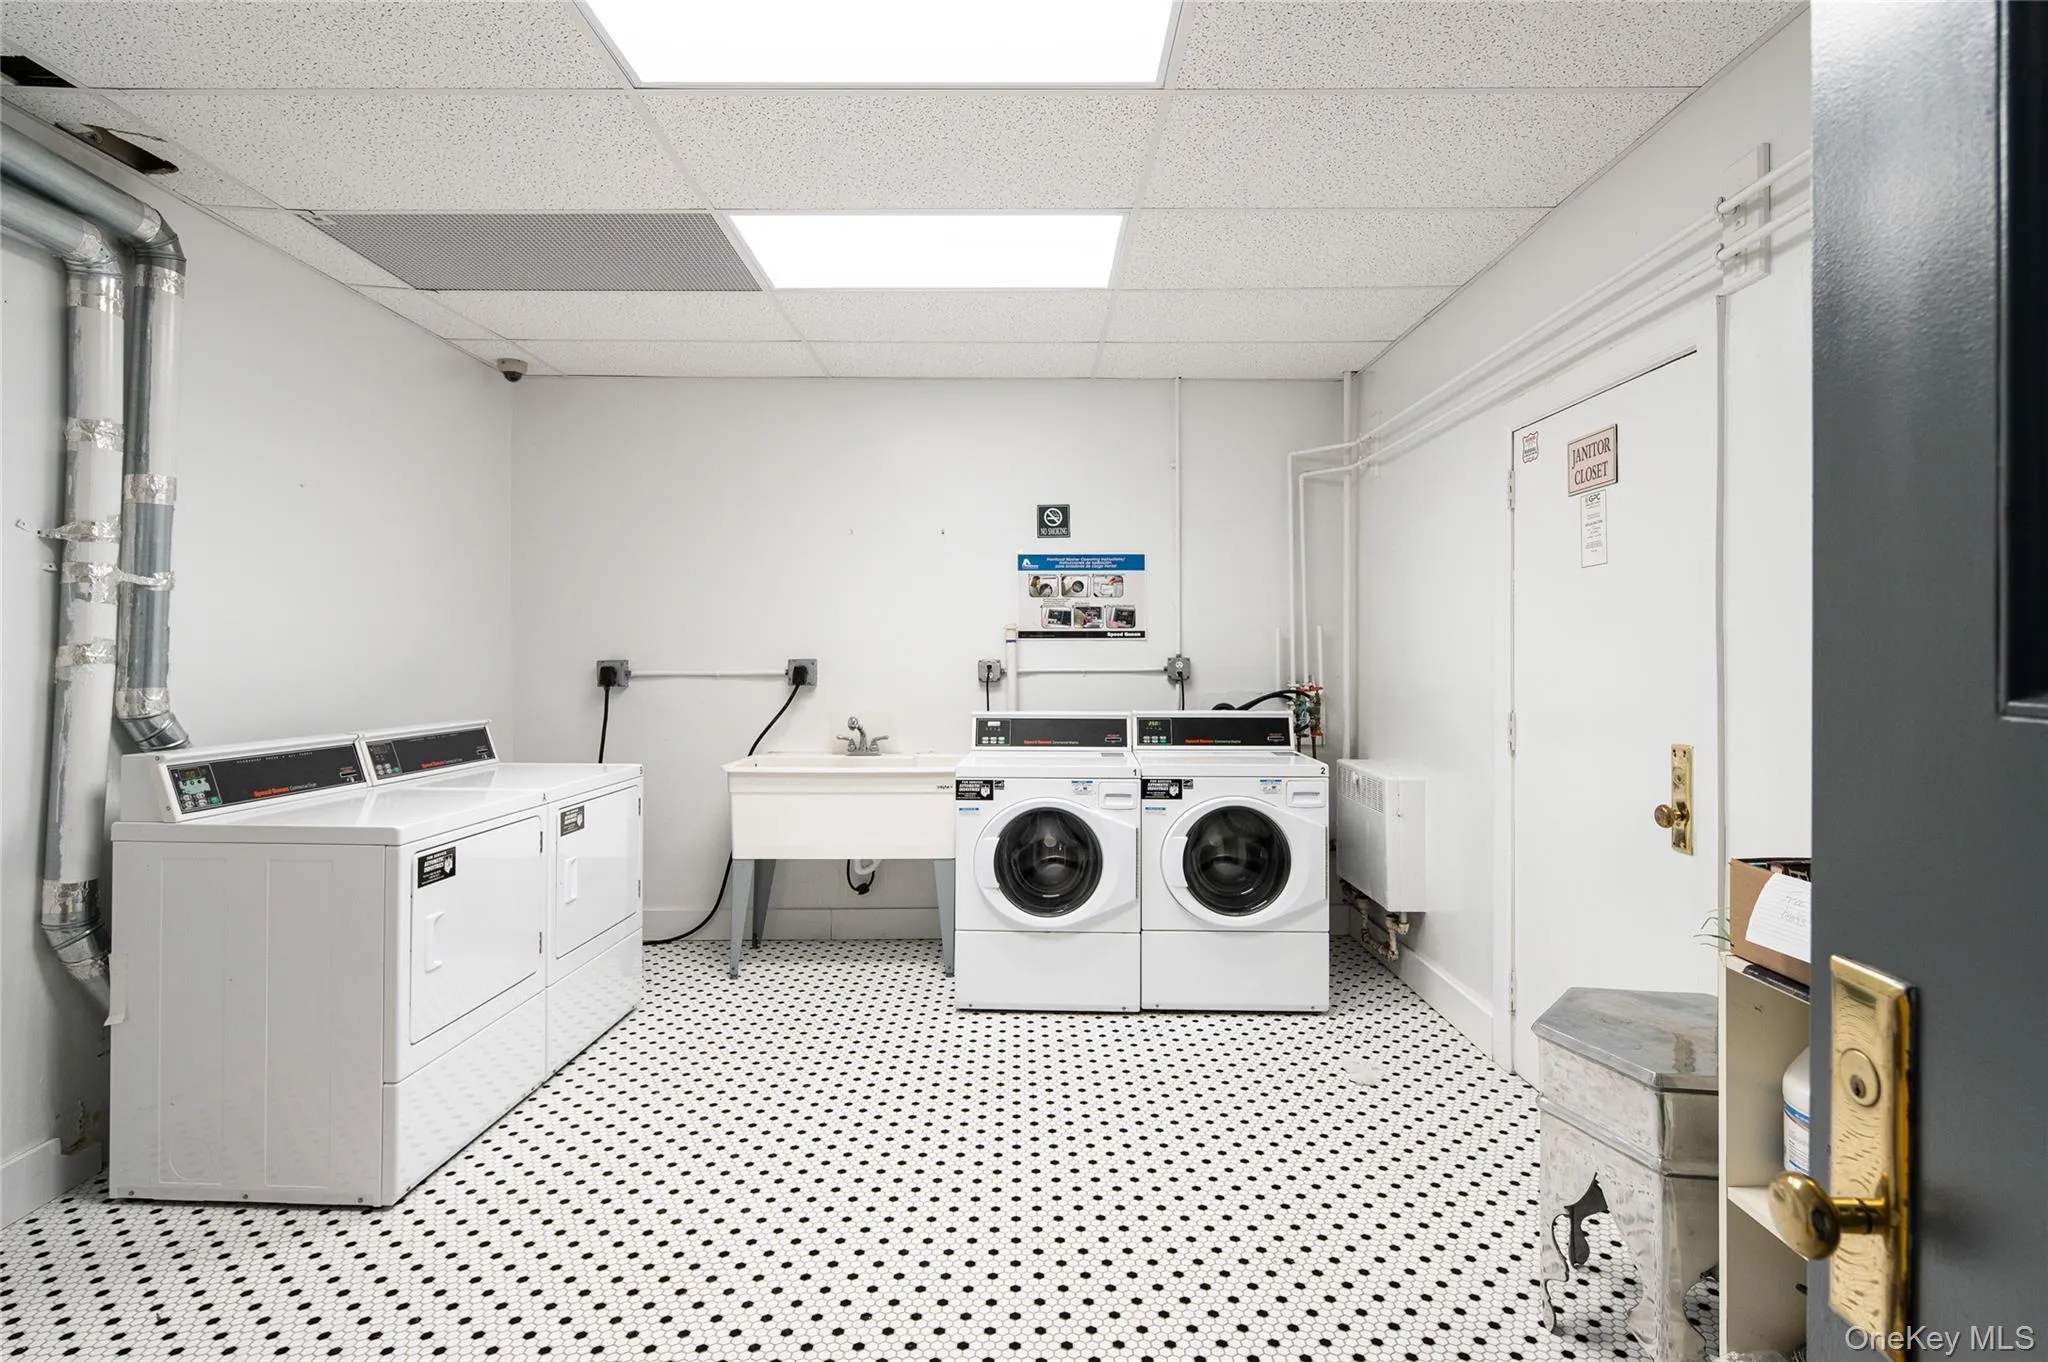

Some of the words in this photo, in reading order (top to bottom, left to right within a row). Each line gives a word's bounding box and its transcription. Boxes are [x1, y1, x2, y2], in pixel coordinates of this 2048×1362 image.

[1571, 437, 1611, 470] JANITOR
[1574, 460, 1608, 485] CLOSET
[1040, 527, 1048, 536] NO
[1048, 527, 1068, 536] SMOKING
[1132, 768, 1137, 776] 1
[1320, 767, 1326, 775] 2
[254, 788, 272, 798] Speed
[272, 786, 289, 795] Queen
